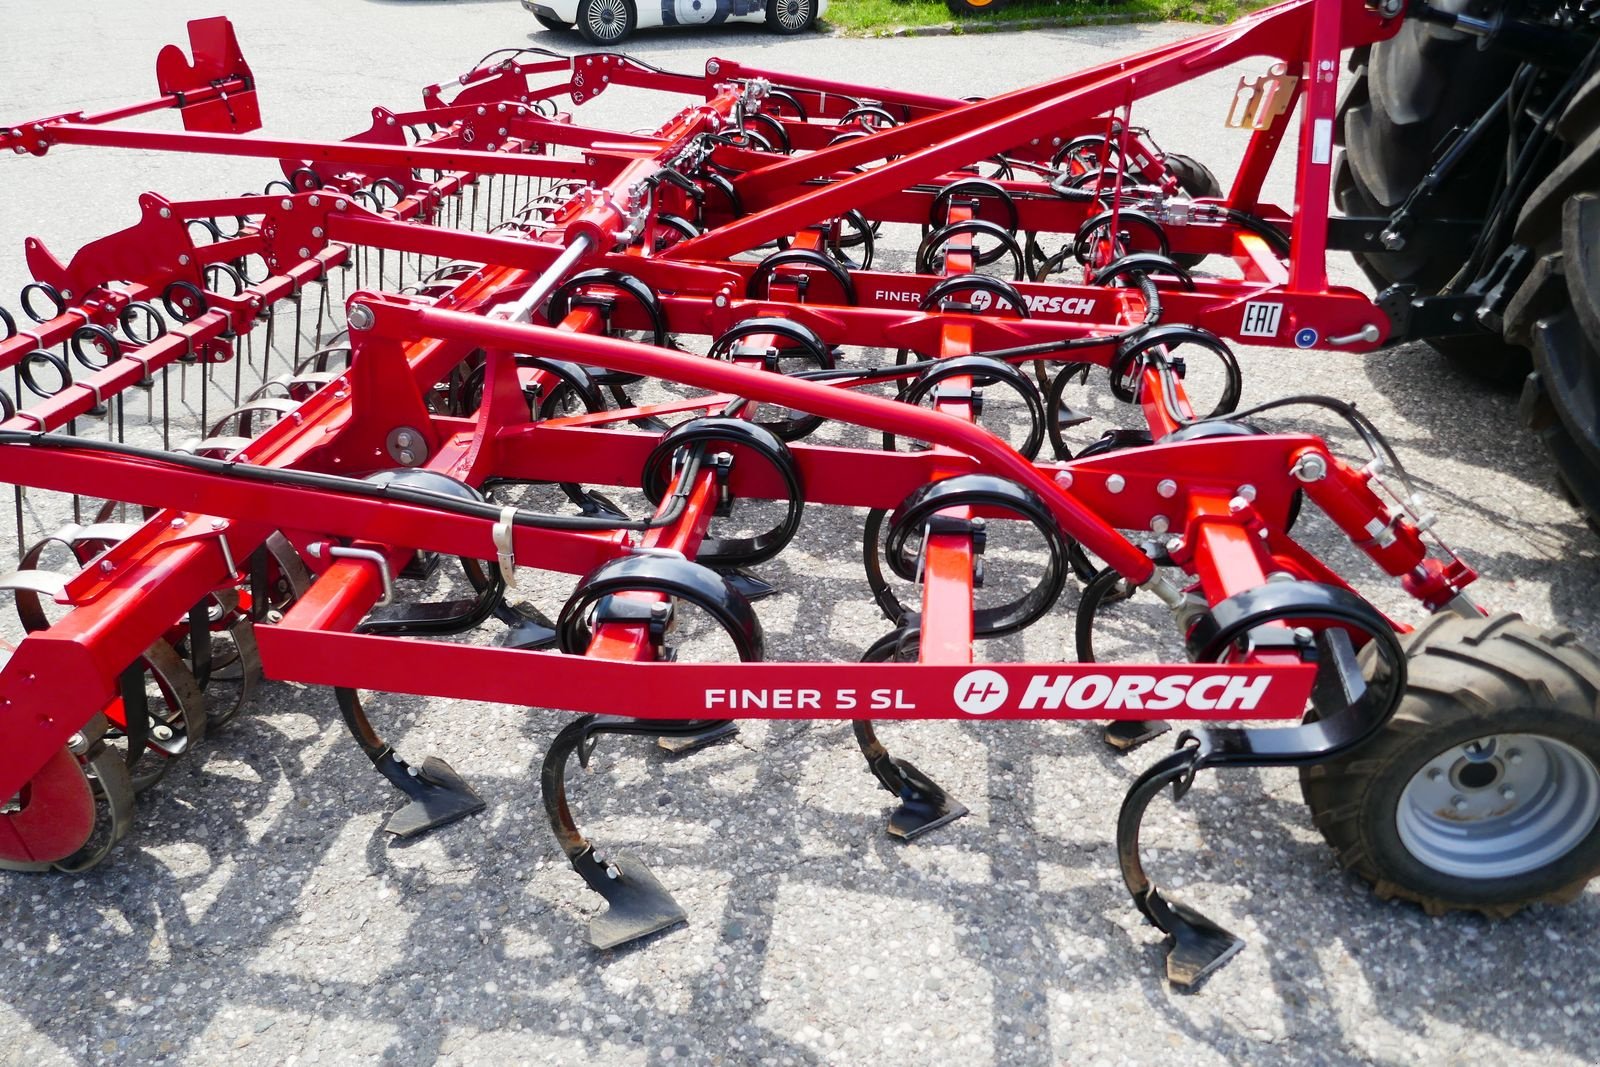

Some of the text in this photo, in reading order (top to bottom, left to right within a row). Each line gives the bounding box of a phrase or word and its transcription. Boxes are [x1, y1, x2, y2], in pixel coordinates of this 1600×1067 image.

[875, 290, 921, 303] FINER
[1243, 304, 1279, 334] EAC
[705, 674, 1273, 710] FINER 5 SL HORSCH
